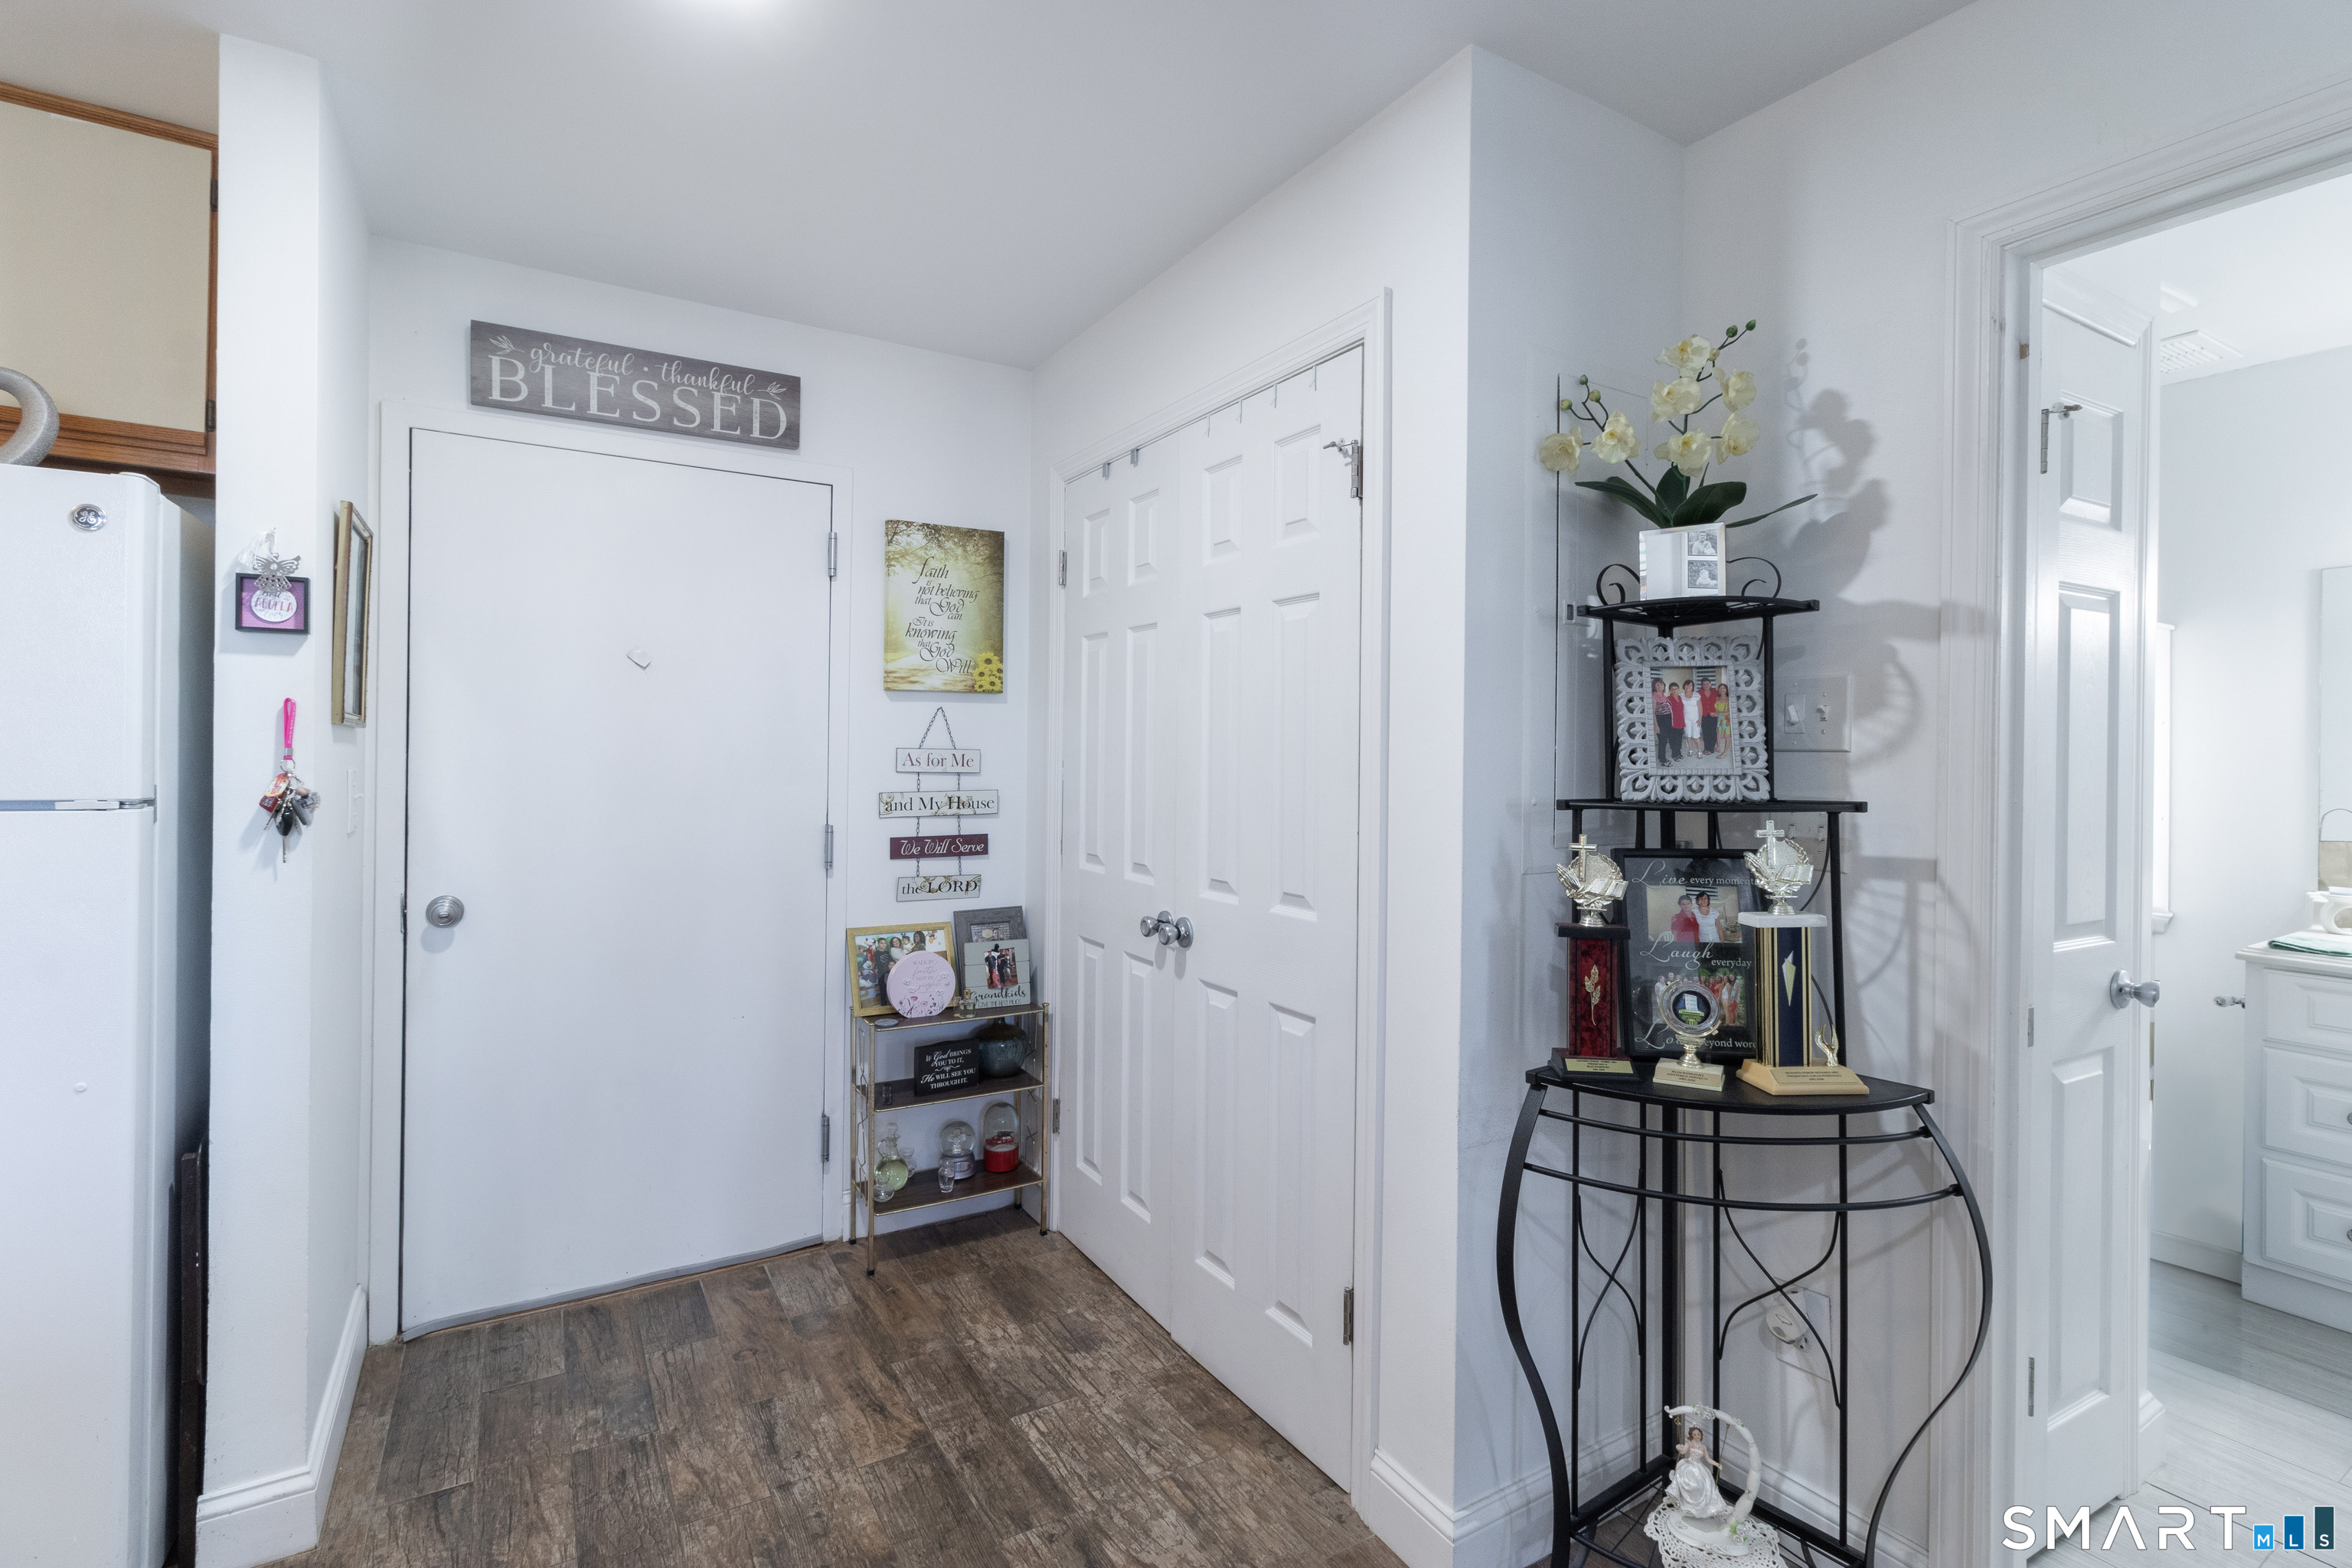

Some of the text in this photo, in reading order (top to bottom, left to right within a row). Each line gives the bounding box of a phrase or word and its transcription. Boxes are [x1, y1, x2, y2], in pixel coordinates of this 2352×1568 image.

[531, 342, 757, 397] grateful thankful
[488, 355, 787, 439] BLESSED
[912, 556, 949, 584] faith
[918, 583, 980, 603] not believing
[255, 597, 293, 612] ABUELA
[915, 595, 965, 616] that God
[912, 616, 926, 626] It
[905, 622, 958, 645] knowing
[917, 639, 955, 662] that God
[903, 752, 974, 767] As for Me
[885, 795, 995, 813] and My House
[900, 838, 985, 855] We Will Serve
[1632, 859, 1690, 889] Live
[1690, 877, 1714, 887] every
[902, 883, 920, 895] the
[1640, 931, 1752, 971] Laugh everyday
[970, 985, 1027, 1004] Grandkids
[1635, 1021, 1756, 1049] Lo eyond wor
[931, 1049, 951, 1067] God
[949, 1049, 972, 1057] BRINGS
[920, 1073, 936, 1084] He
[930, 1079, 960, 1089] THROUGH
